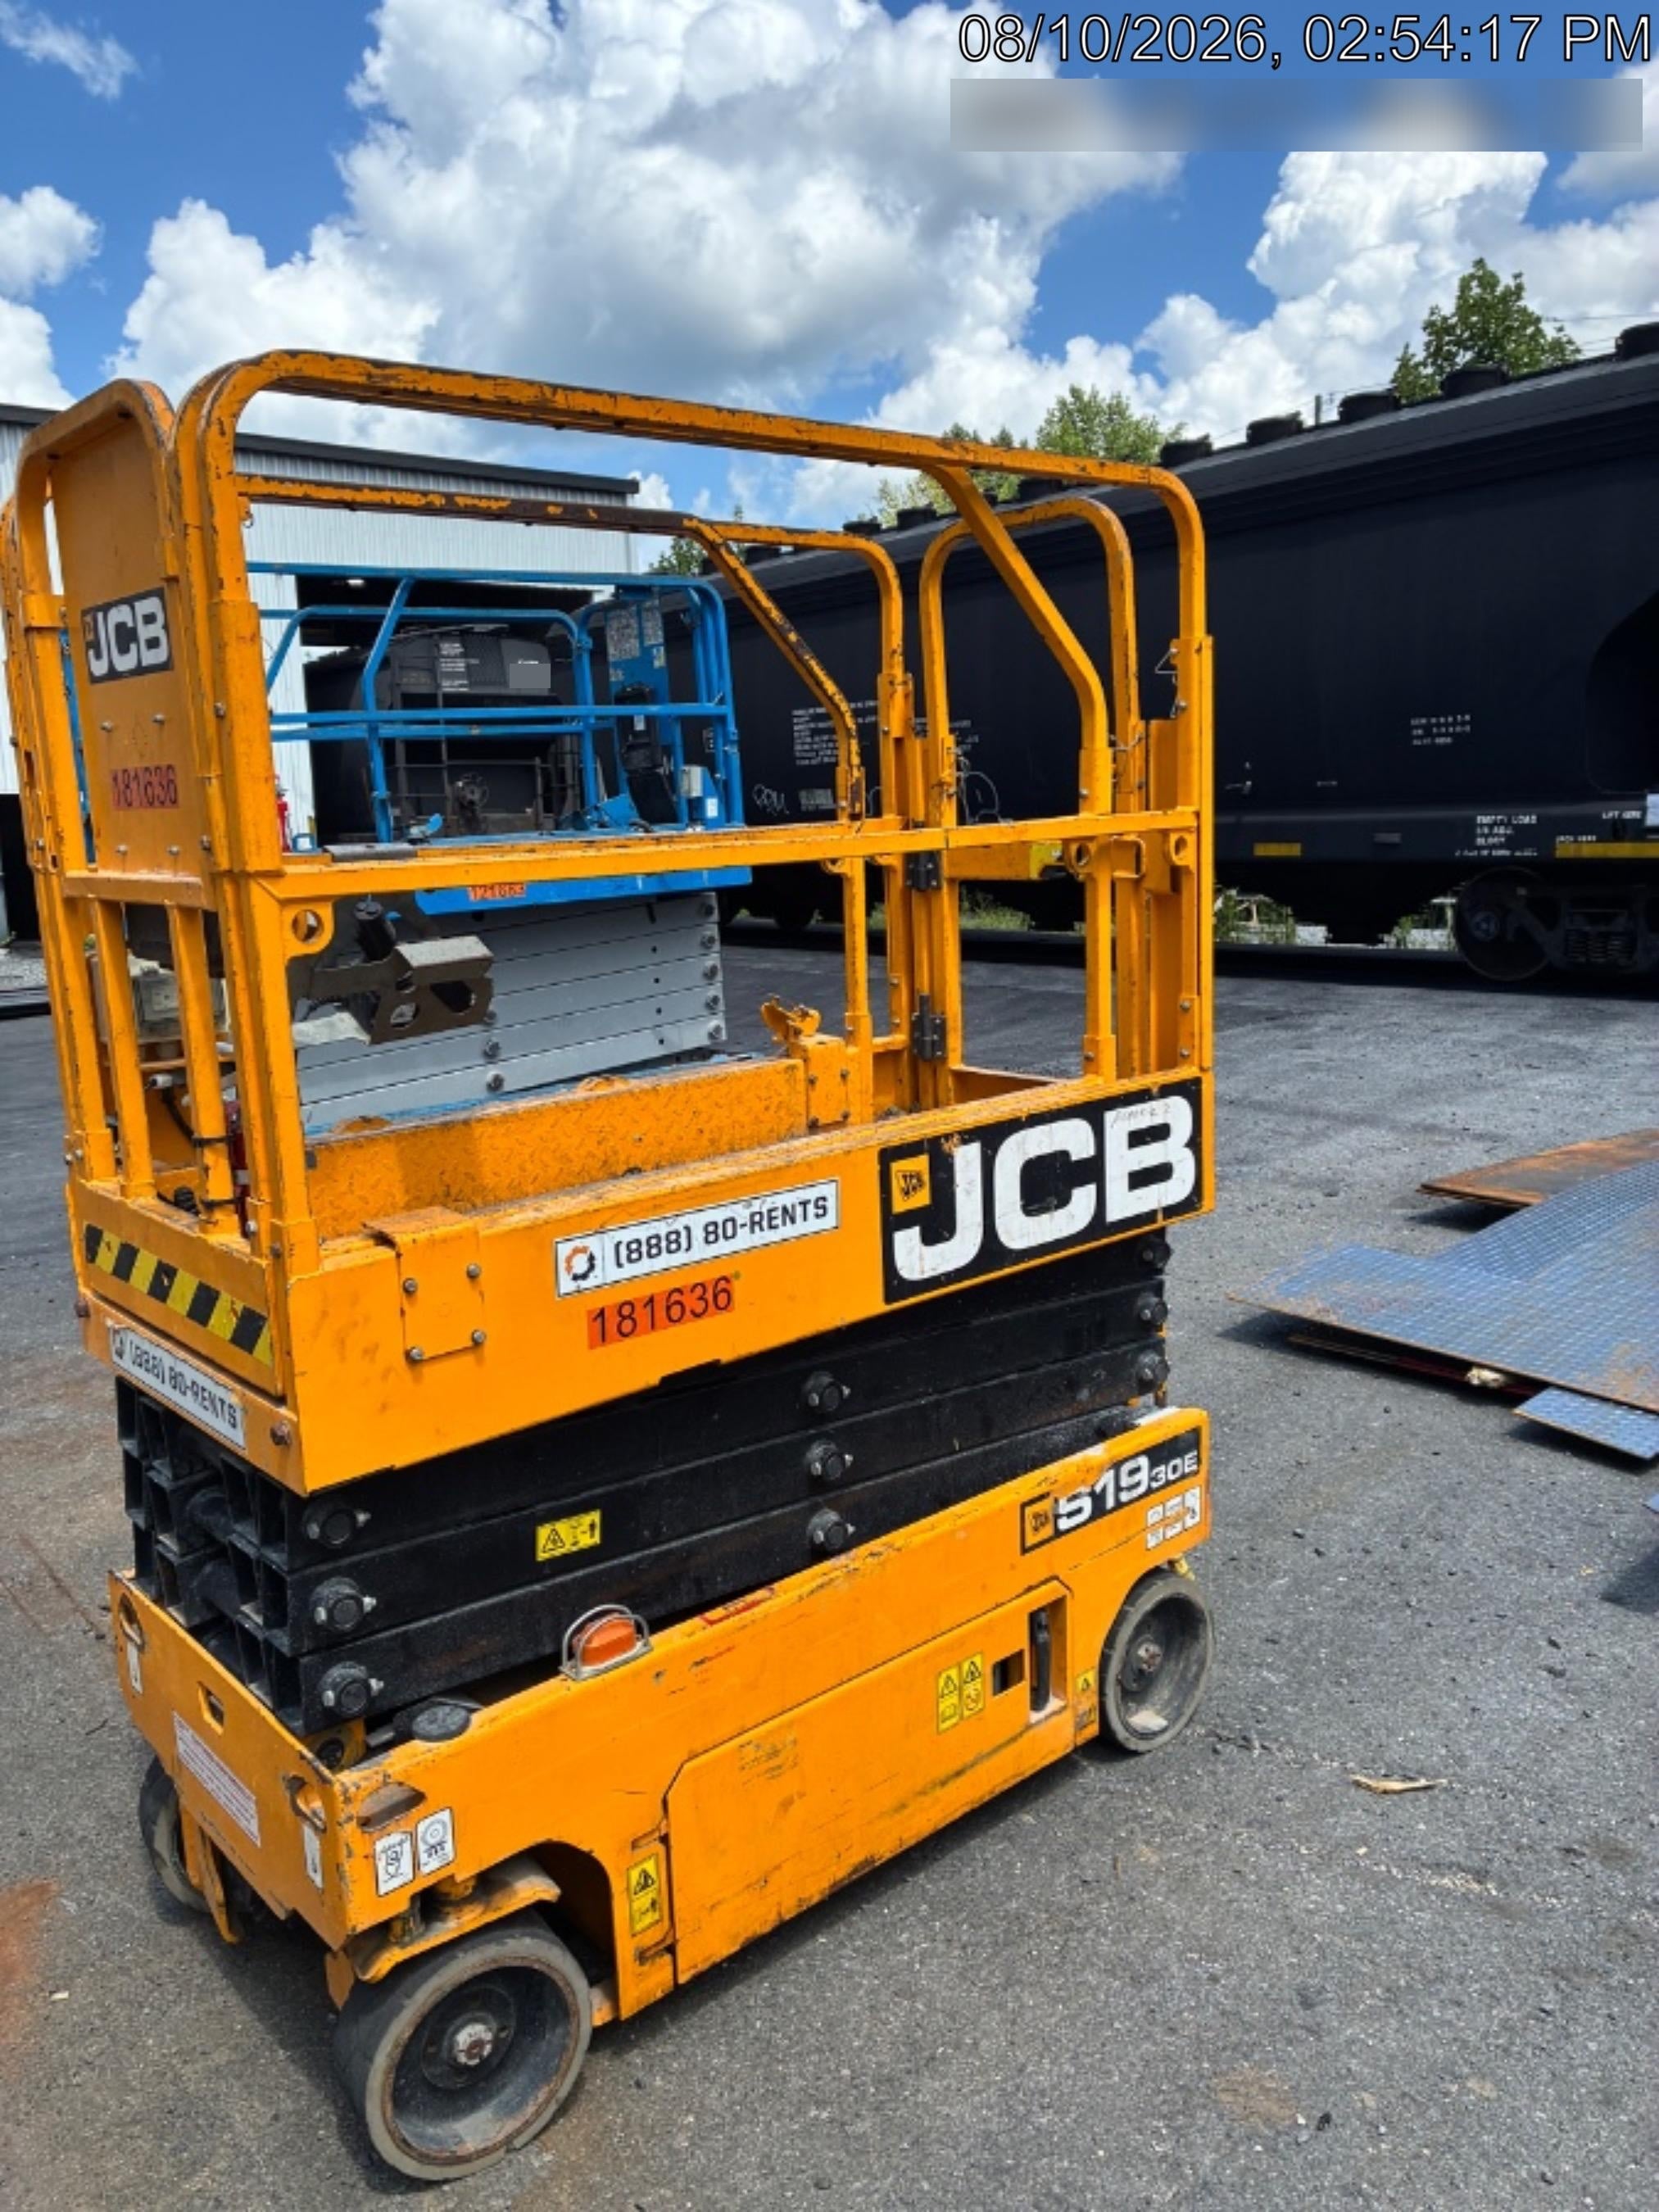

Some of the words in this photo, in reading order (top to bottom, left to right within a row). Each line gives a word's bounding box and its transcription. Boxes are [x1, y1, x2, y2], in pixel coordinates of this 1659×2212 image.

[88, 596, 170, 677] JCB
[111, 764, 177, 807] 181636
[893, 1095, 1196, 1281] JCB
[614, 1225, 692, 1269] (888)
[703, 1196, 829, 1245] 80-RENTS
[592, 1276, 732, 1344] 181636
[168, 1366, 238, 1430] 80-RENTS
